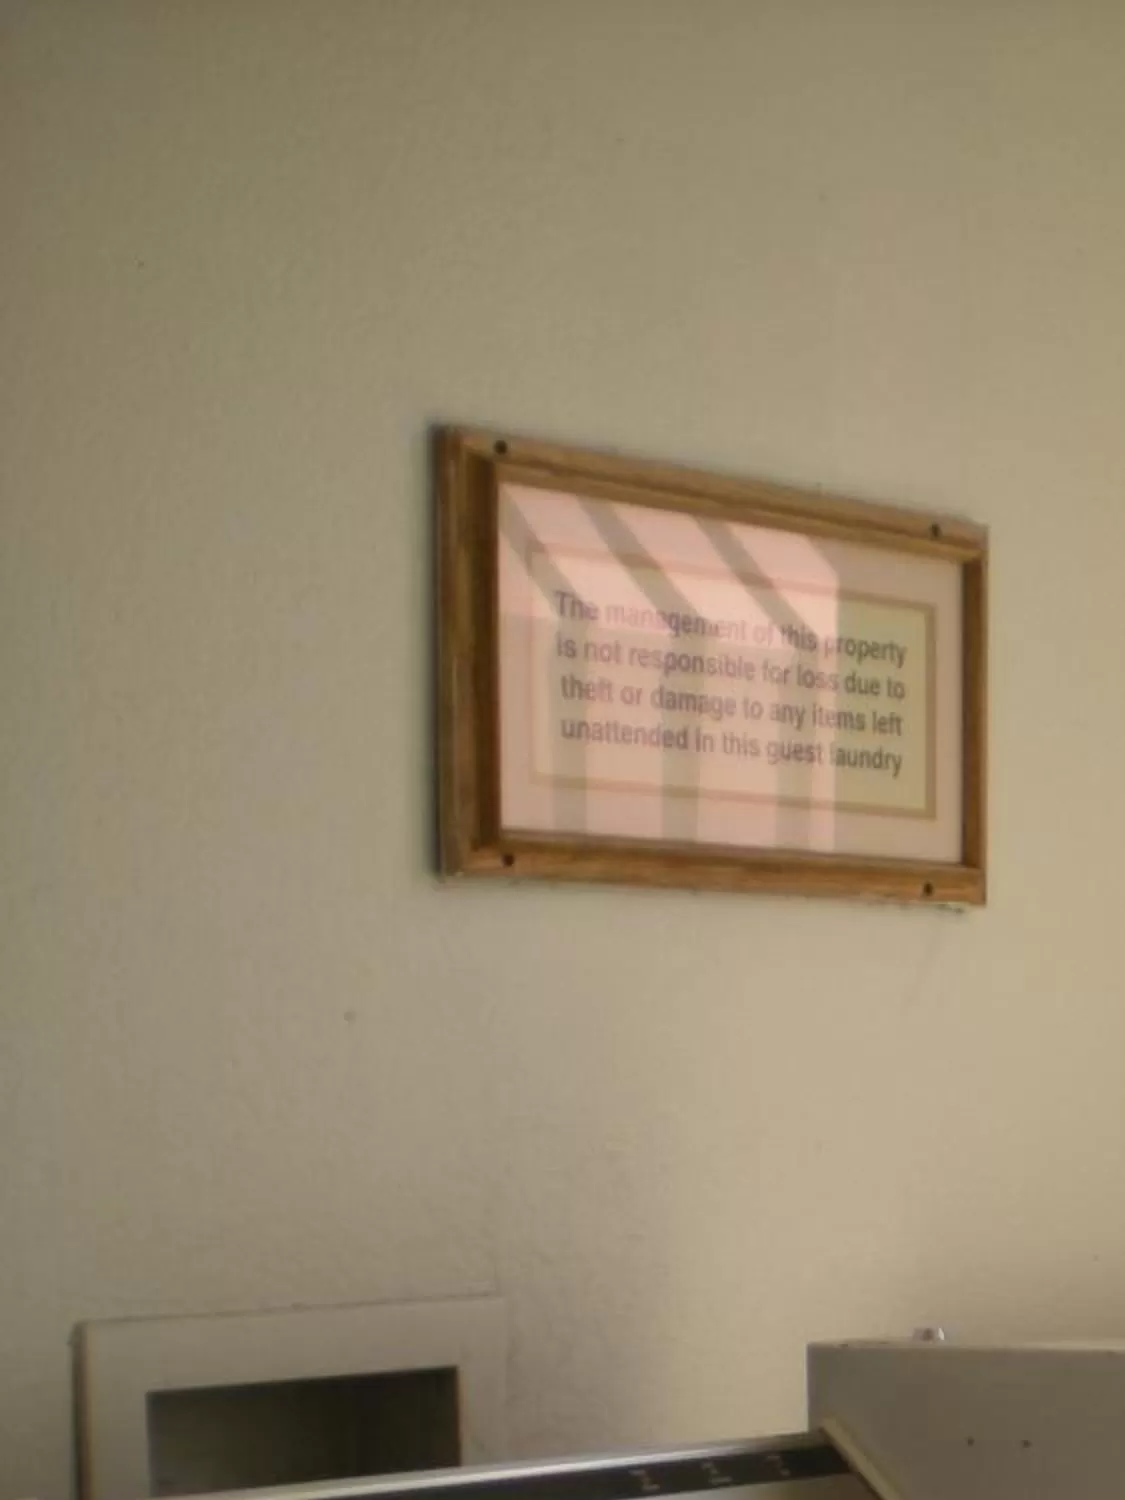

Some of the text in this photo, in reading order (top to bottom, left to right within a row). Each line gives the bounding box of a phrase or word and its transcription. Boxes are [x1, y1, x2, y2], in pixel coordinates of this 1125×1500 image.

[555, 589, 908, 669] The management of this property
[583, 639, 622, 665] not
[629, 645, 756, 682] responsible
[762, 660, 791, 688] for
[796, 662, 839, 691] loss
[844, 671, 882, 697] due
[887, 676, 906, 701] to
[561, 674, 903, 737] theft or damage to any items left
[561, 717, 689, 751] unattended
[722, 729, 761, 758] this
[767, 740, 823, 767] guest
[829, 744, 903, 778] laundry
